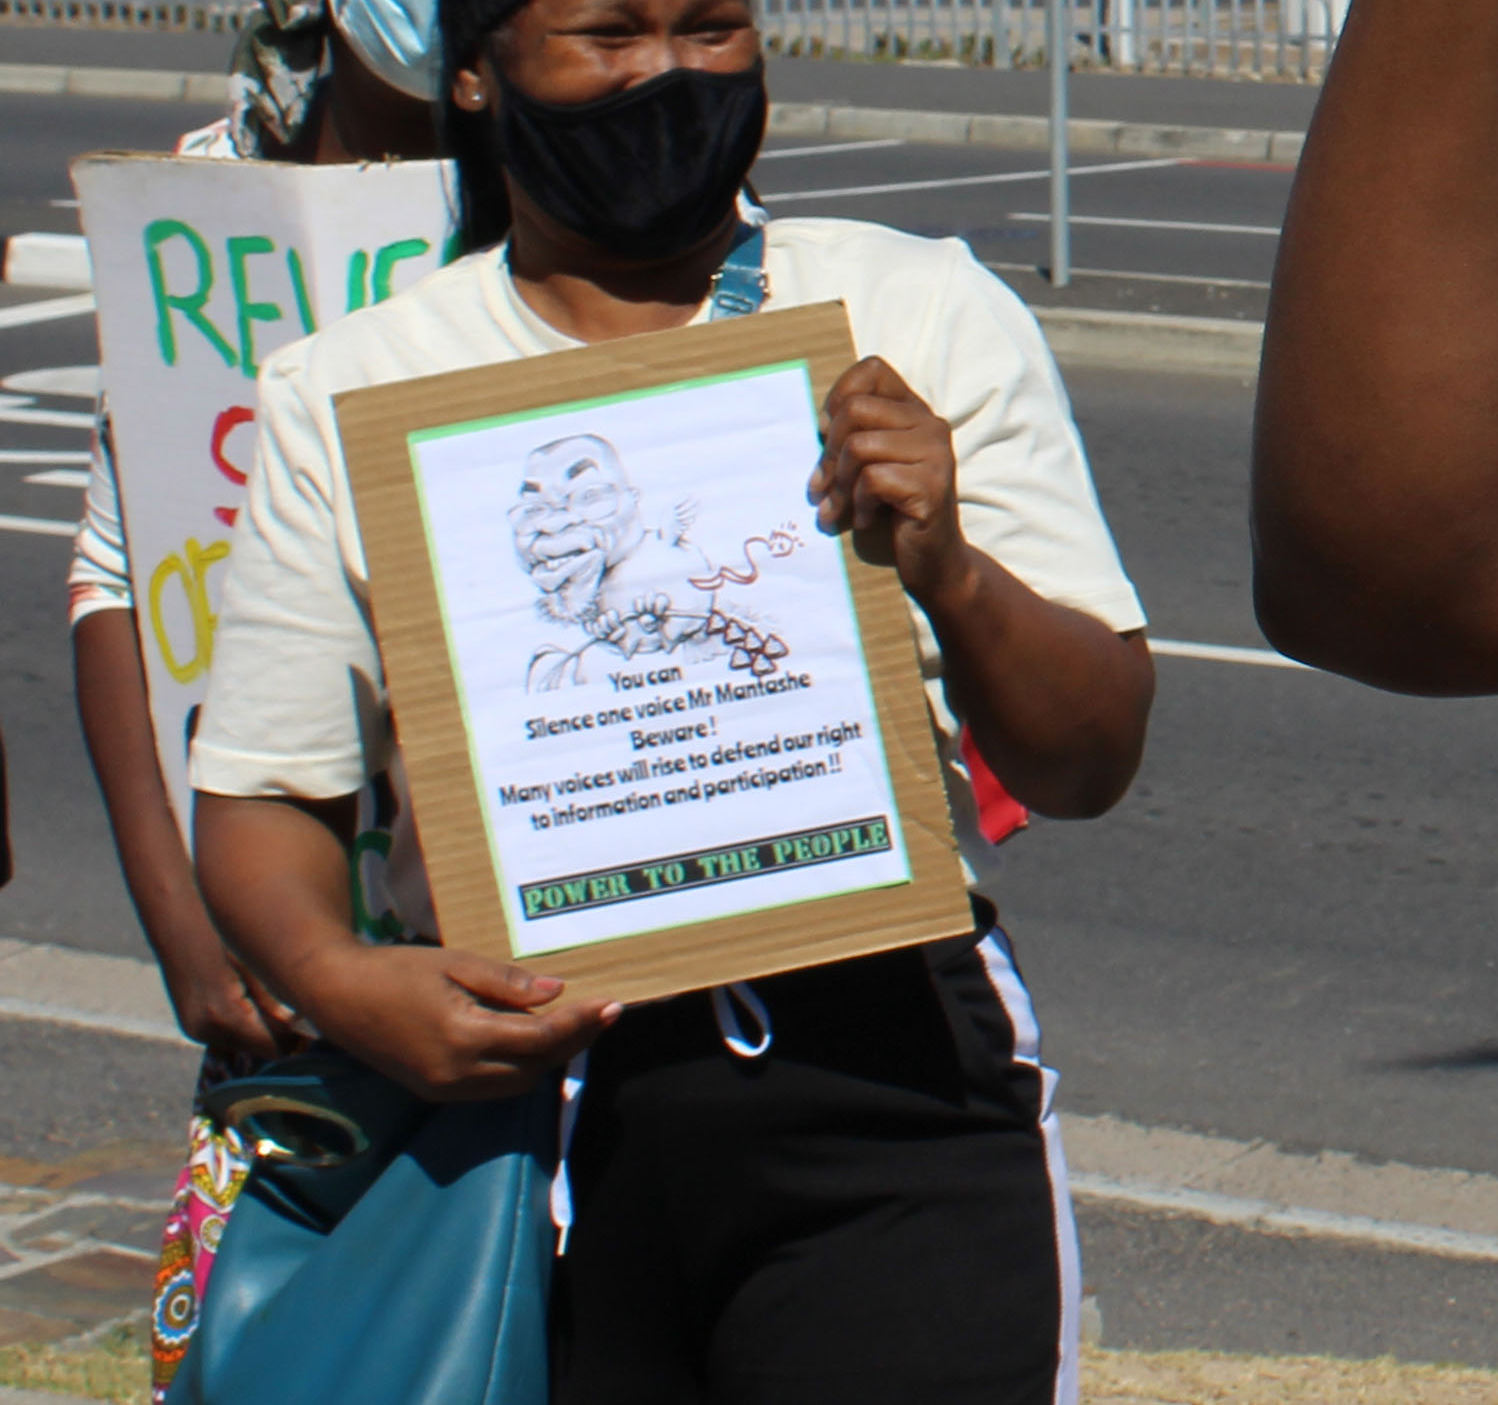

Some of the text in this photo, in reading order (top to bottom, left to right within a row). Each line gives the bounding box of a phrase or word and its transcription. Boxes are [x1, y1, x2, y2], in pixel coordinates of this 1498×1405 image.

[525, 671, 812, 741] Silence one voice Mr Mantashe
[608, 666, 682, 691] You can
[500, 720, 862, 805] Many voices will rise to defend our right
[531, 812, 551, 831] to
[552, 791, 661, 827] information
[663, 780, 703, 805] and
[524, 823, 888, 915] POWER TO THE PEOPLE
